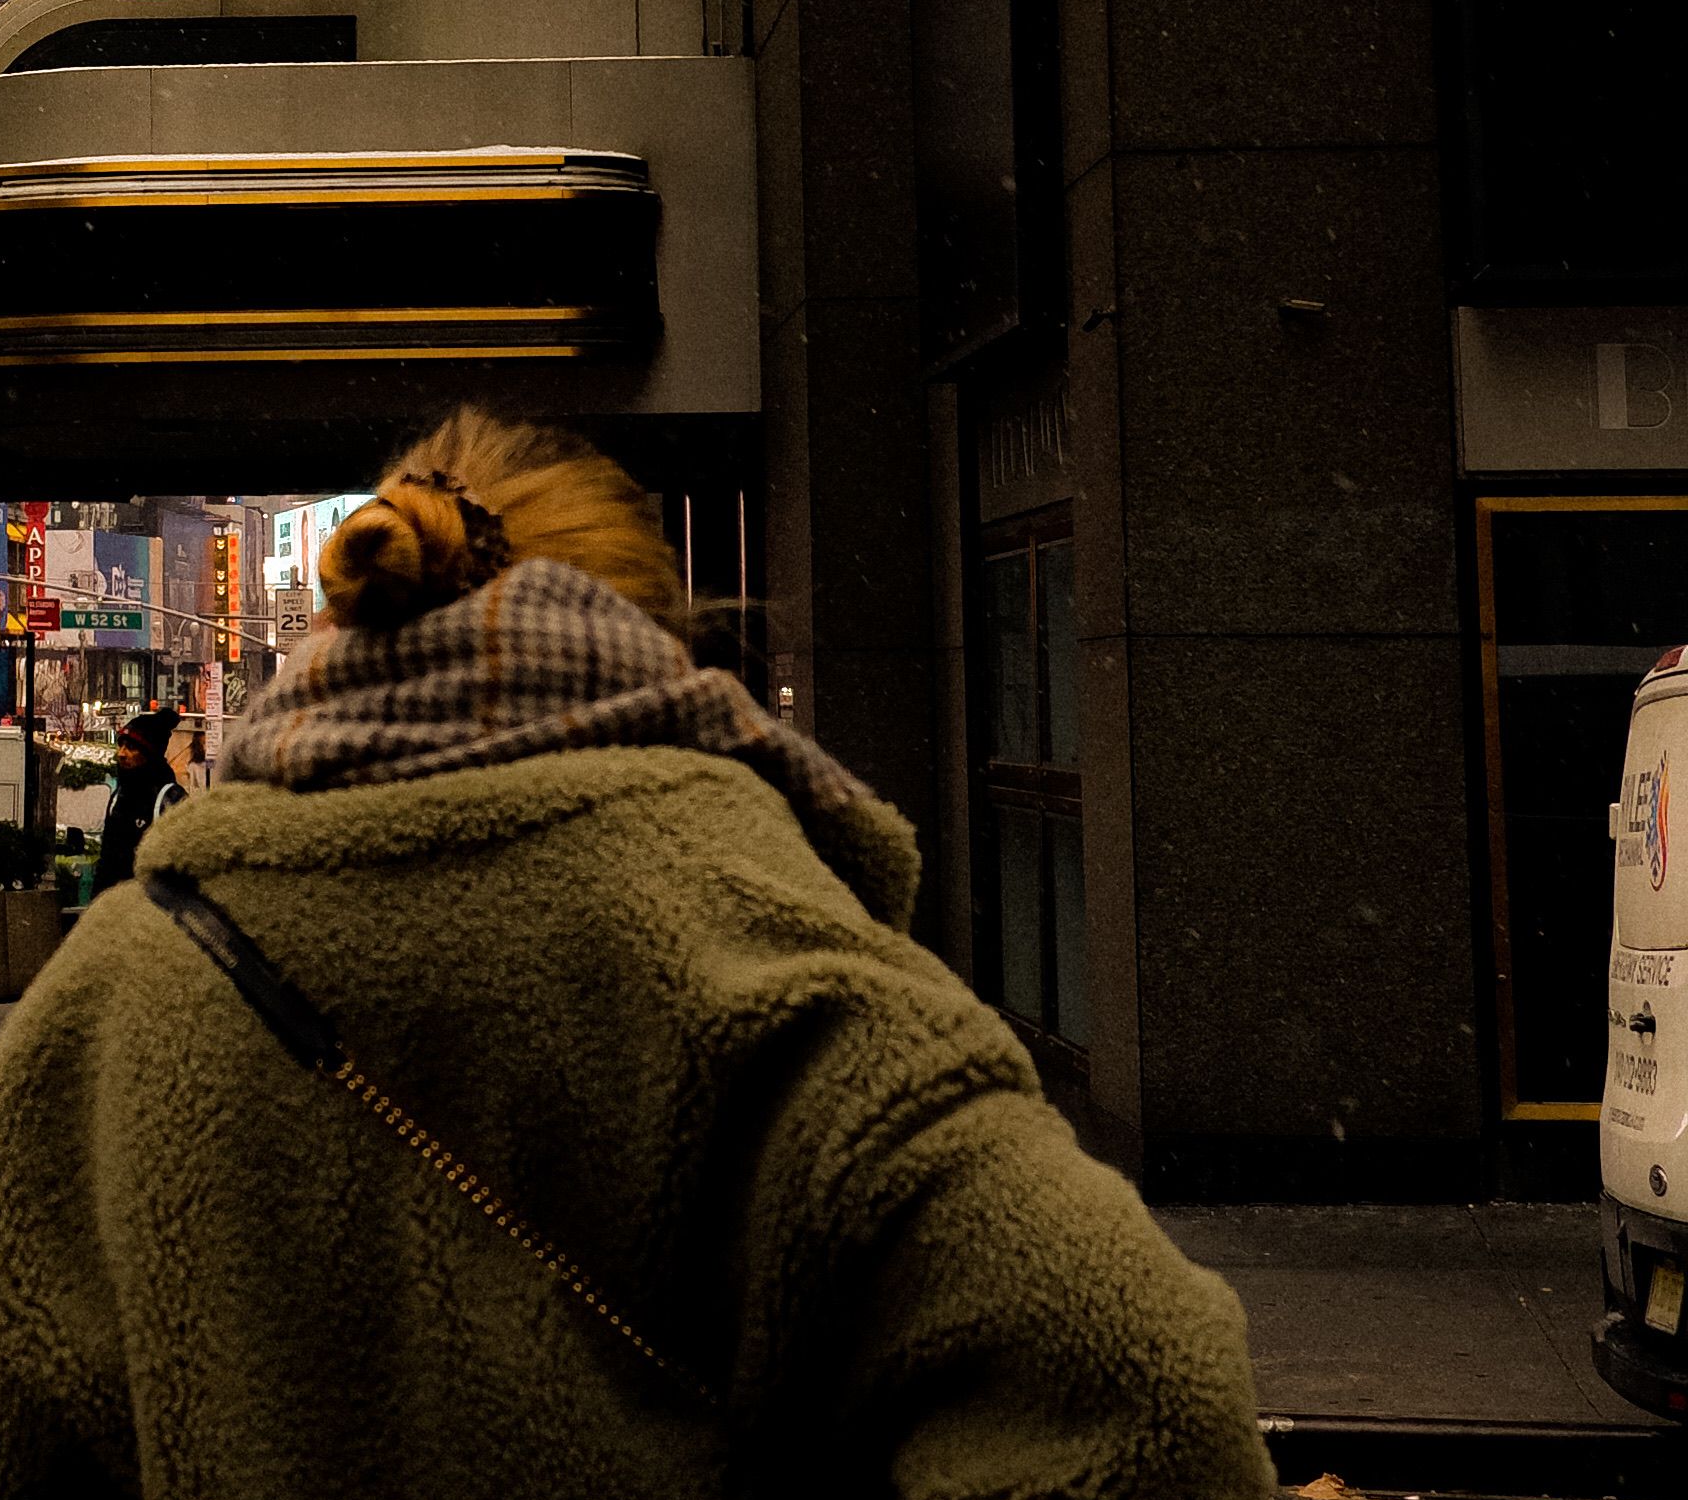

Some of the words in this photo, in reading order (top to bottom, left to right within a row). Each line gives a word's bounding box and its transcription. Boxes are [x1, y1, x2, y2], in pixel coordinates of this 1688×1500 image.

[75, 614, 86, 625] W
[91, 614, 108, 626] 52
[113, 615, 128, 627] St
[281, 614, 308, 631] 25
